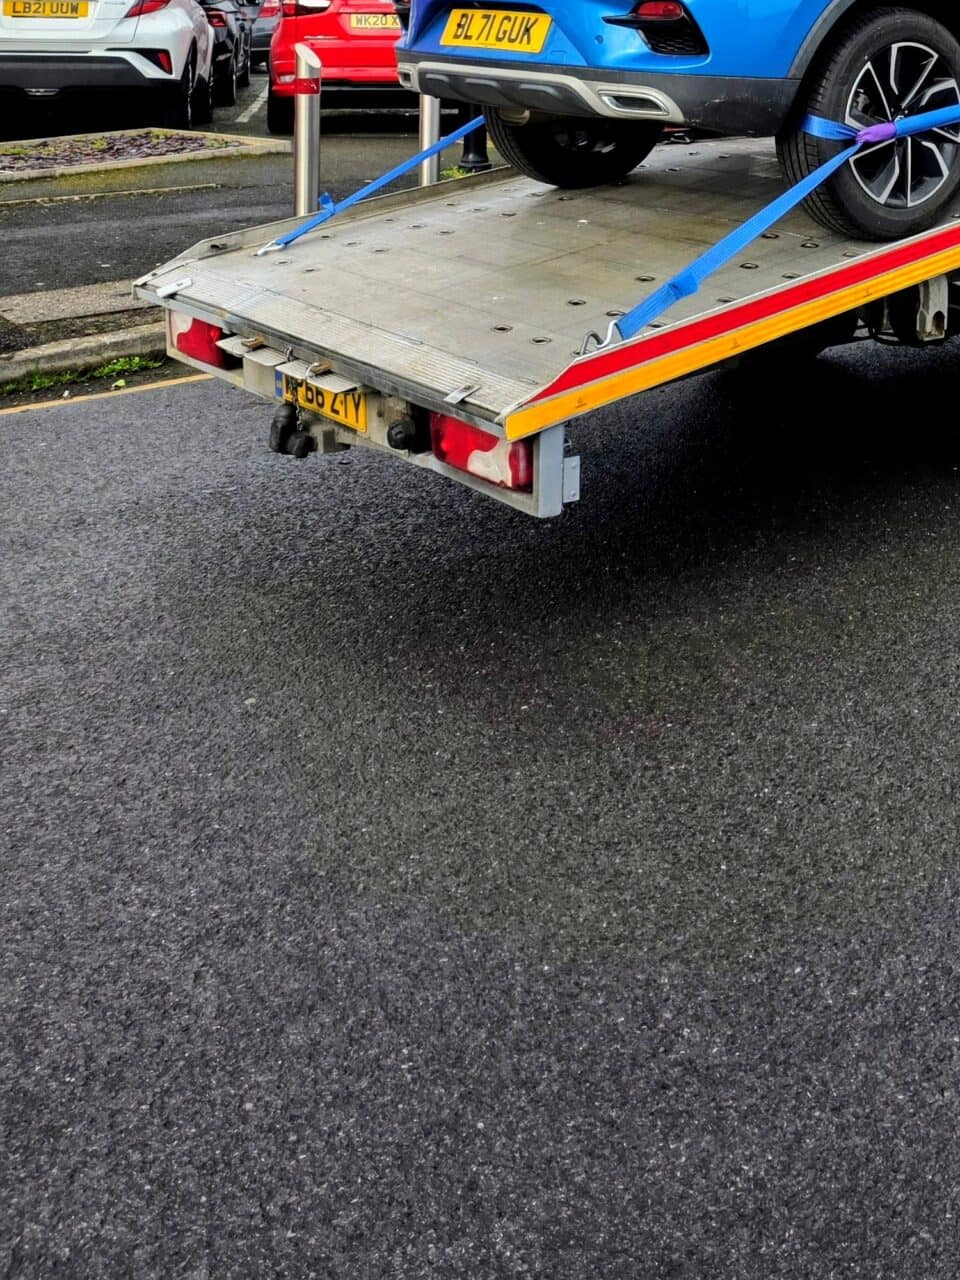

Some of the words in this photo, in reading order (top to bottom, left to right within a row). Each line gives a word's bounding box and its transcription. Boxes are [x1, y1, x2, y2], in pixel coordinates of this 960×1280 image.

[12, 1, 46, 14] LB21
[50, 1, 79, 15] UUW
[355, 15, 388, 26] WK20
[453, 13, 496, 41] BL71
[496, 15, 539, 45] GUK
